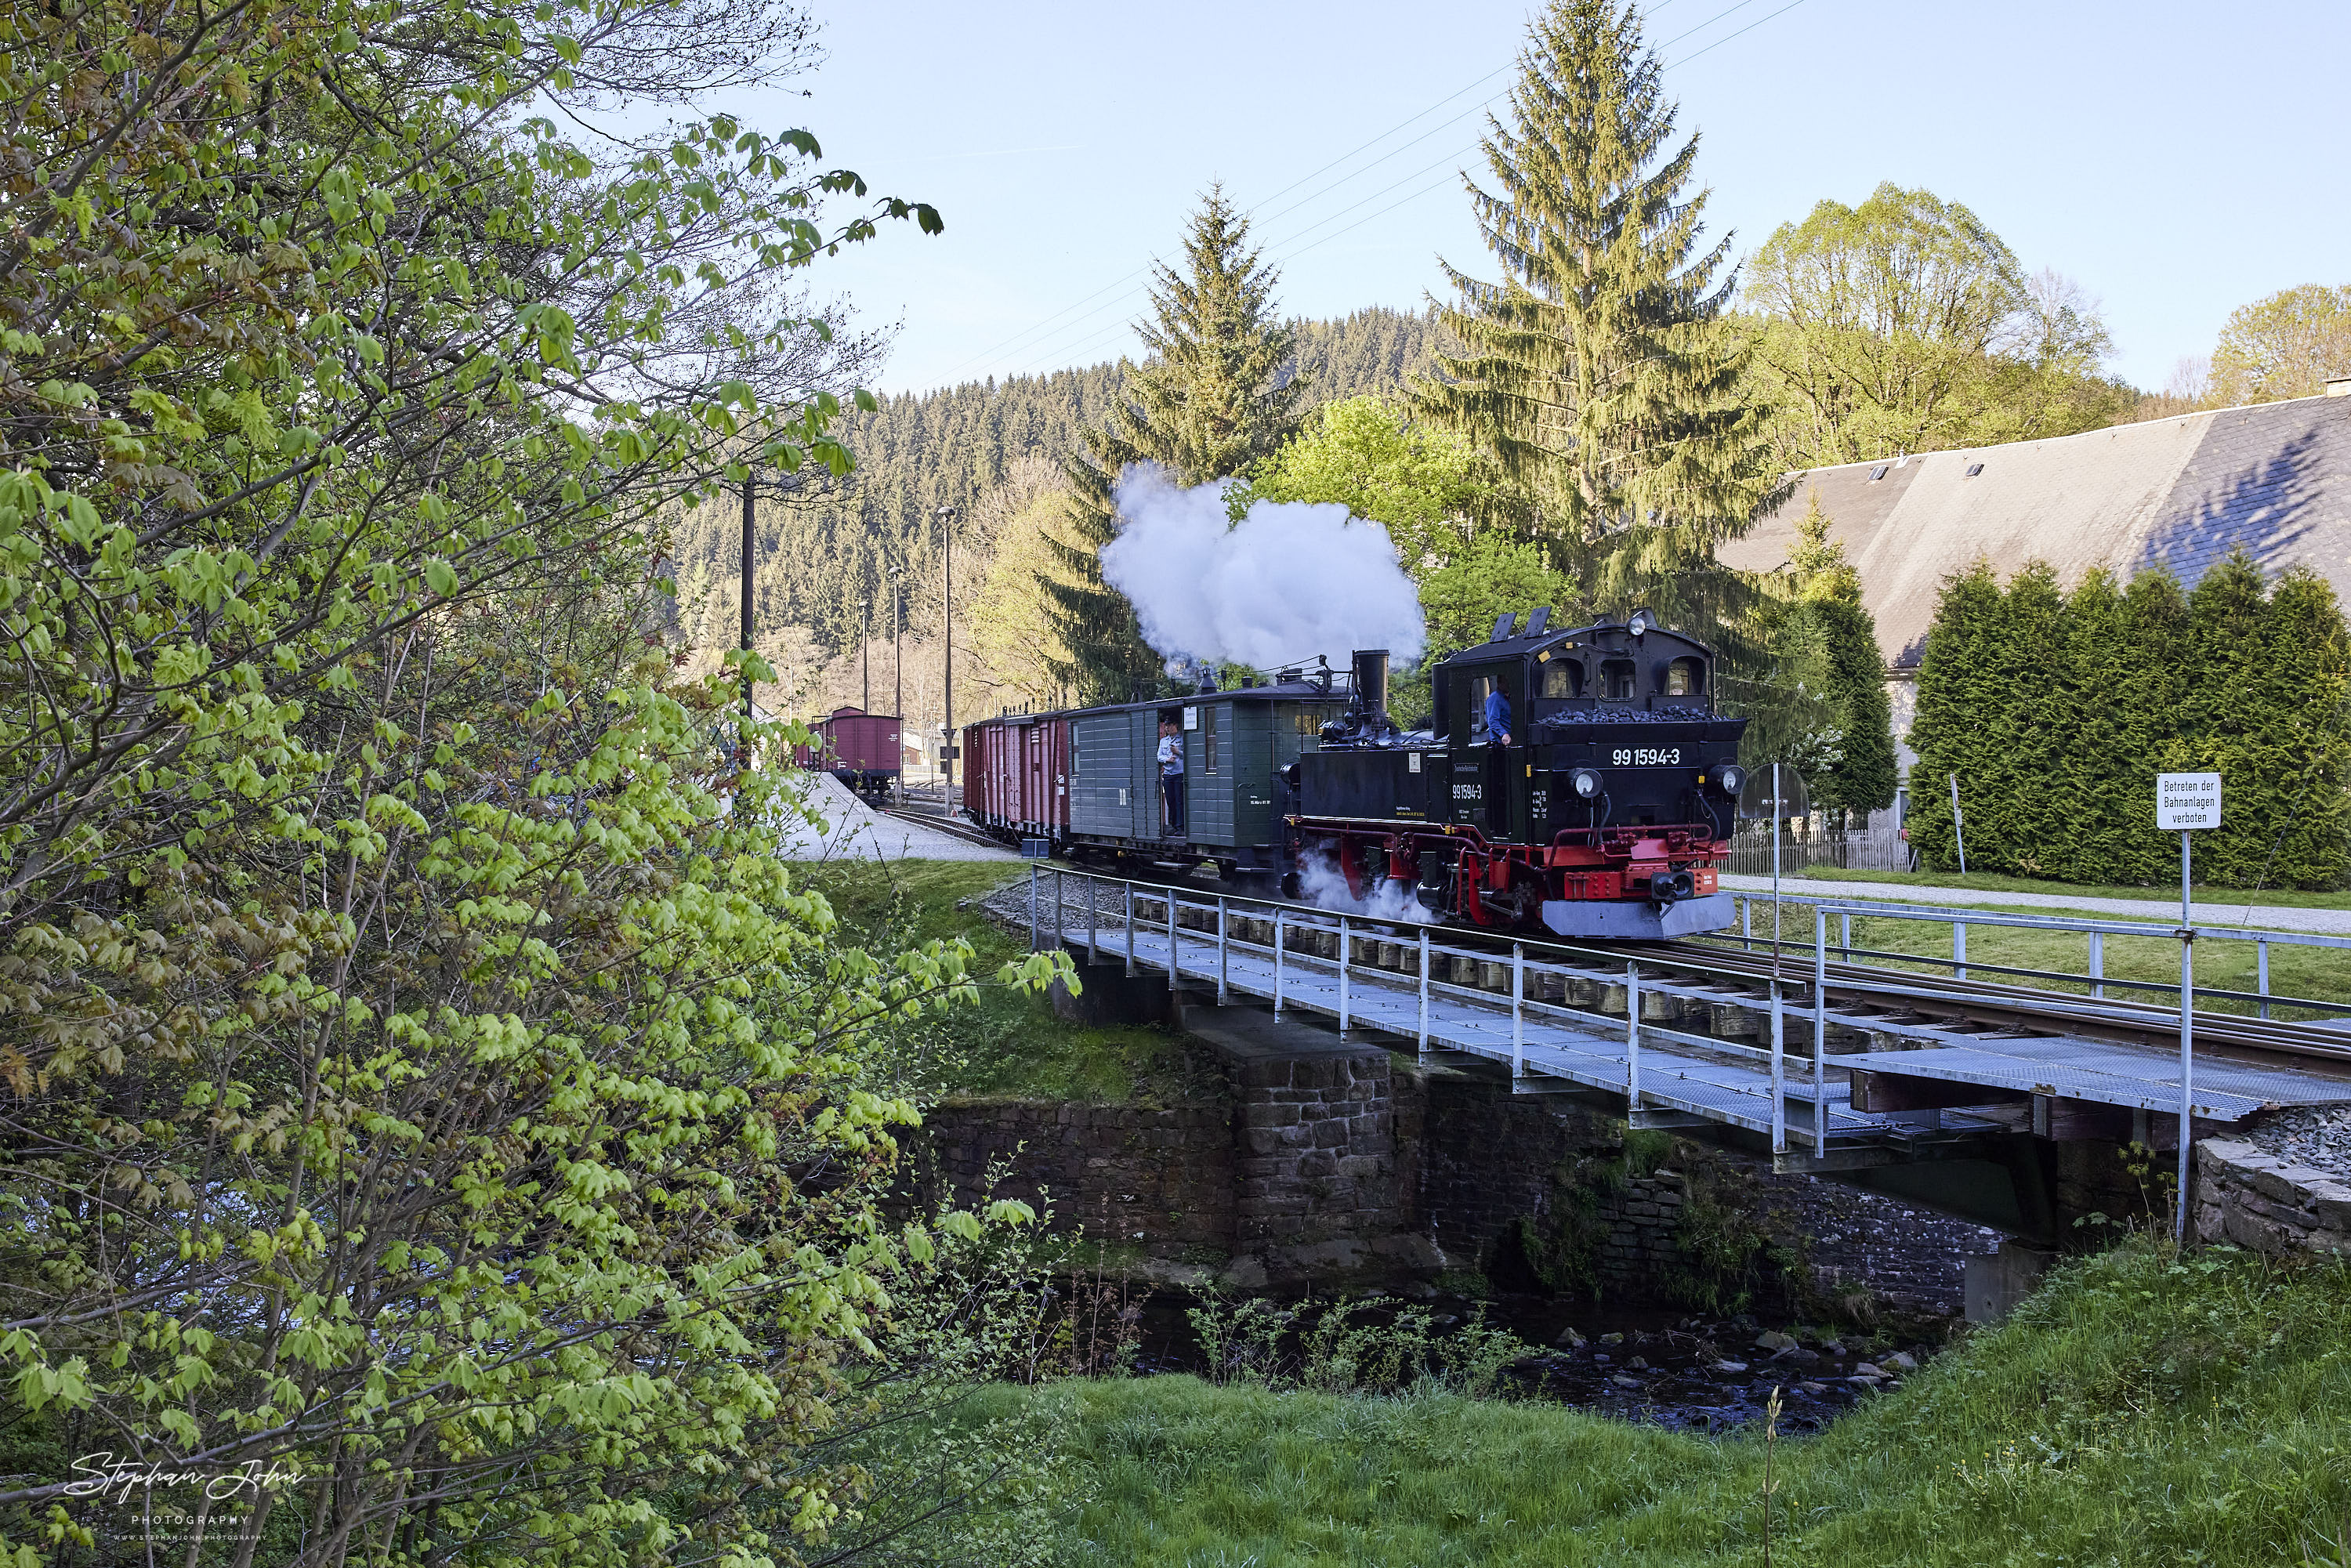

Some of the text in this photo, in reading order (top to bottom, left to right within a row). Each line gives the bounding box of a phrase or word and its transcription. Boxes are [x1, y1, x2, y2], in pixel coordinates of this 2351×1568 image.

[1613, 748, 1680, 765] 99 1594-3
[2164, 780, 2214, 791] Betreten der
[2164, 796, 2215, 809] Bahnanlagen
[2172, 812, 2207, 823] verboten
